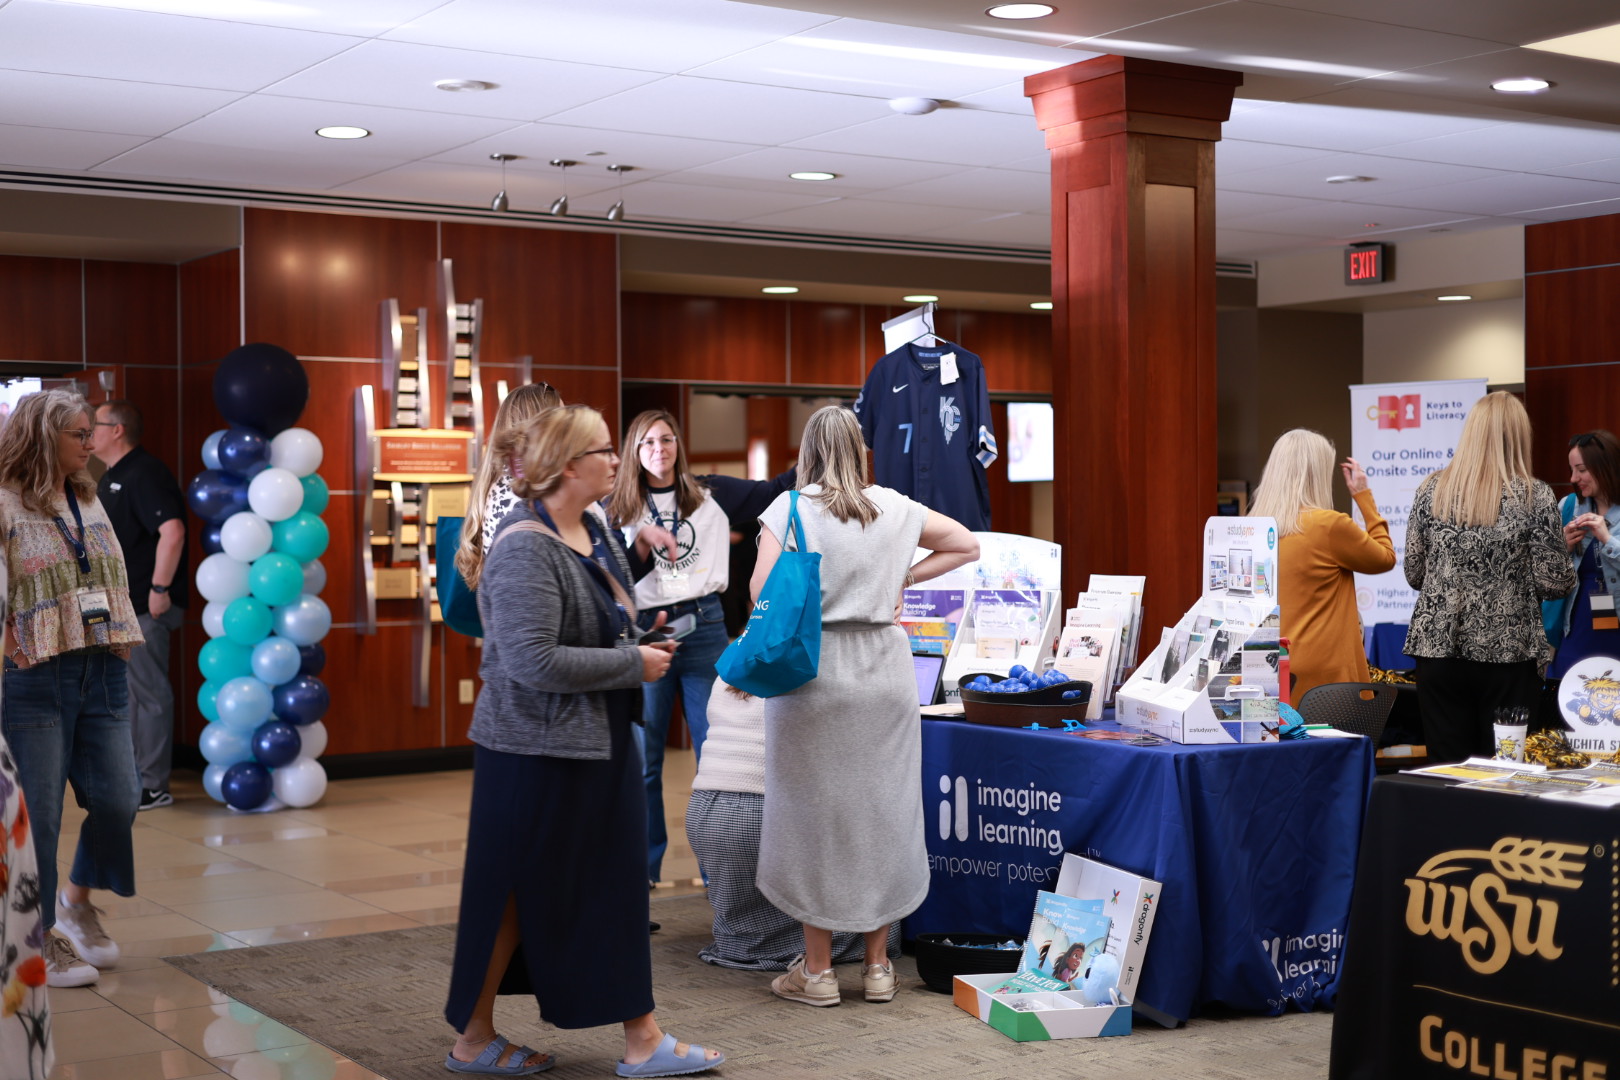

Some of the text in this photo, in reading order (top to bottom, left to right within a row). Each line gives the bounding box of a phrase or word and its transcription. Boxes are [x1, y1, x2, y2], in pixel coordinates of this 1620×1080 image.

[1350, 250, 1377, 280] EXIT
[1426, 400, 1463, 411] Keys to
[1426, 411, 1467, 421] Literacy
[898, 422, 913, 454] 7
[1372, 450, 1397, 461] Our
[1400, 448, 1443, 460] Online
[1365, 462, 1447, 478] Onsite Servi
[1377, 588, 1409, 599] Higher
[903, 602, 936, 611] Knowledge
[977, 778, 1062, 816] imagine
[978, 815, 1064, 856] learning
[927, 853, 1002, 878] empower
[1133, 903, 1150, 946] dragonfly
[1419, 1014, 1608, 1080] COLLEGE
